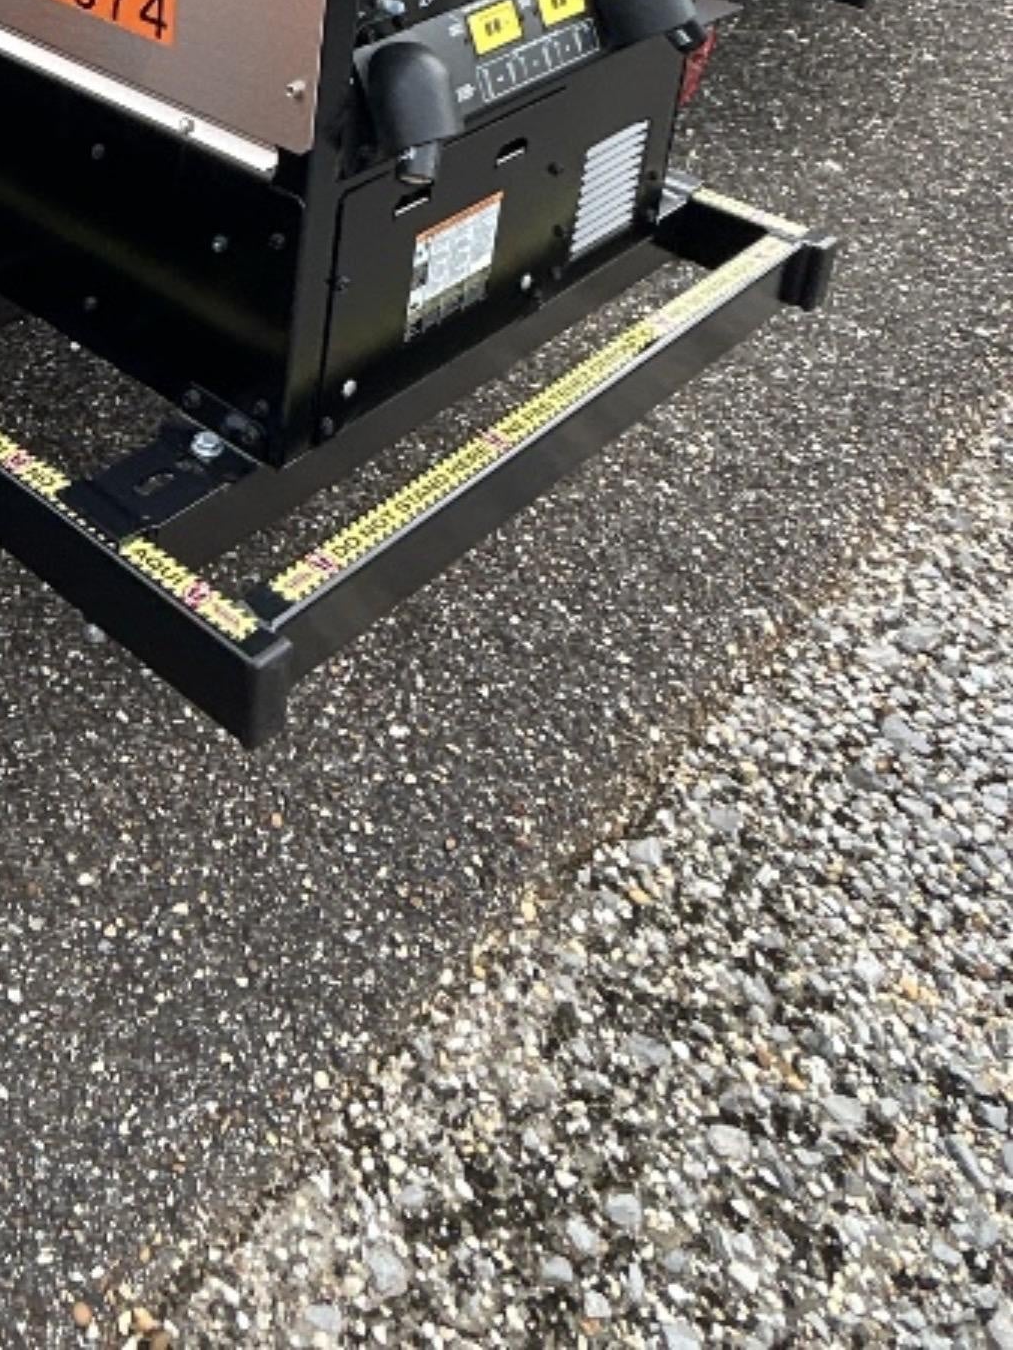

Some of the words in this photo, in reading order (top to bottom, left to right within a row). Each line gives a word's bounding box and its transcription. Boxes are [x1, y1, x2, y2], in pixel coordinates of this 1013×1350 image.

[330, 532, 360, 558] DO
[356, 507, 395, 539] NOT
[393, 470, 450, 514] STAND
[135, 547, 184, 587] AQUI
